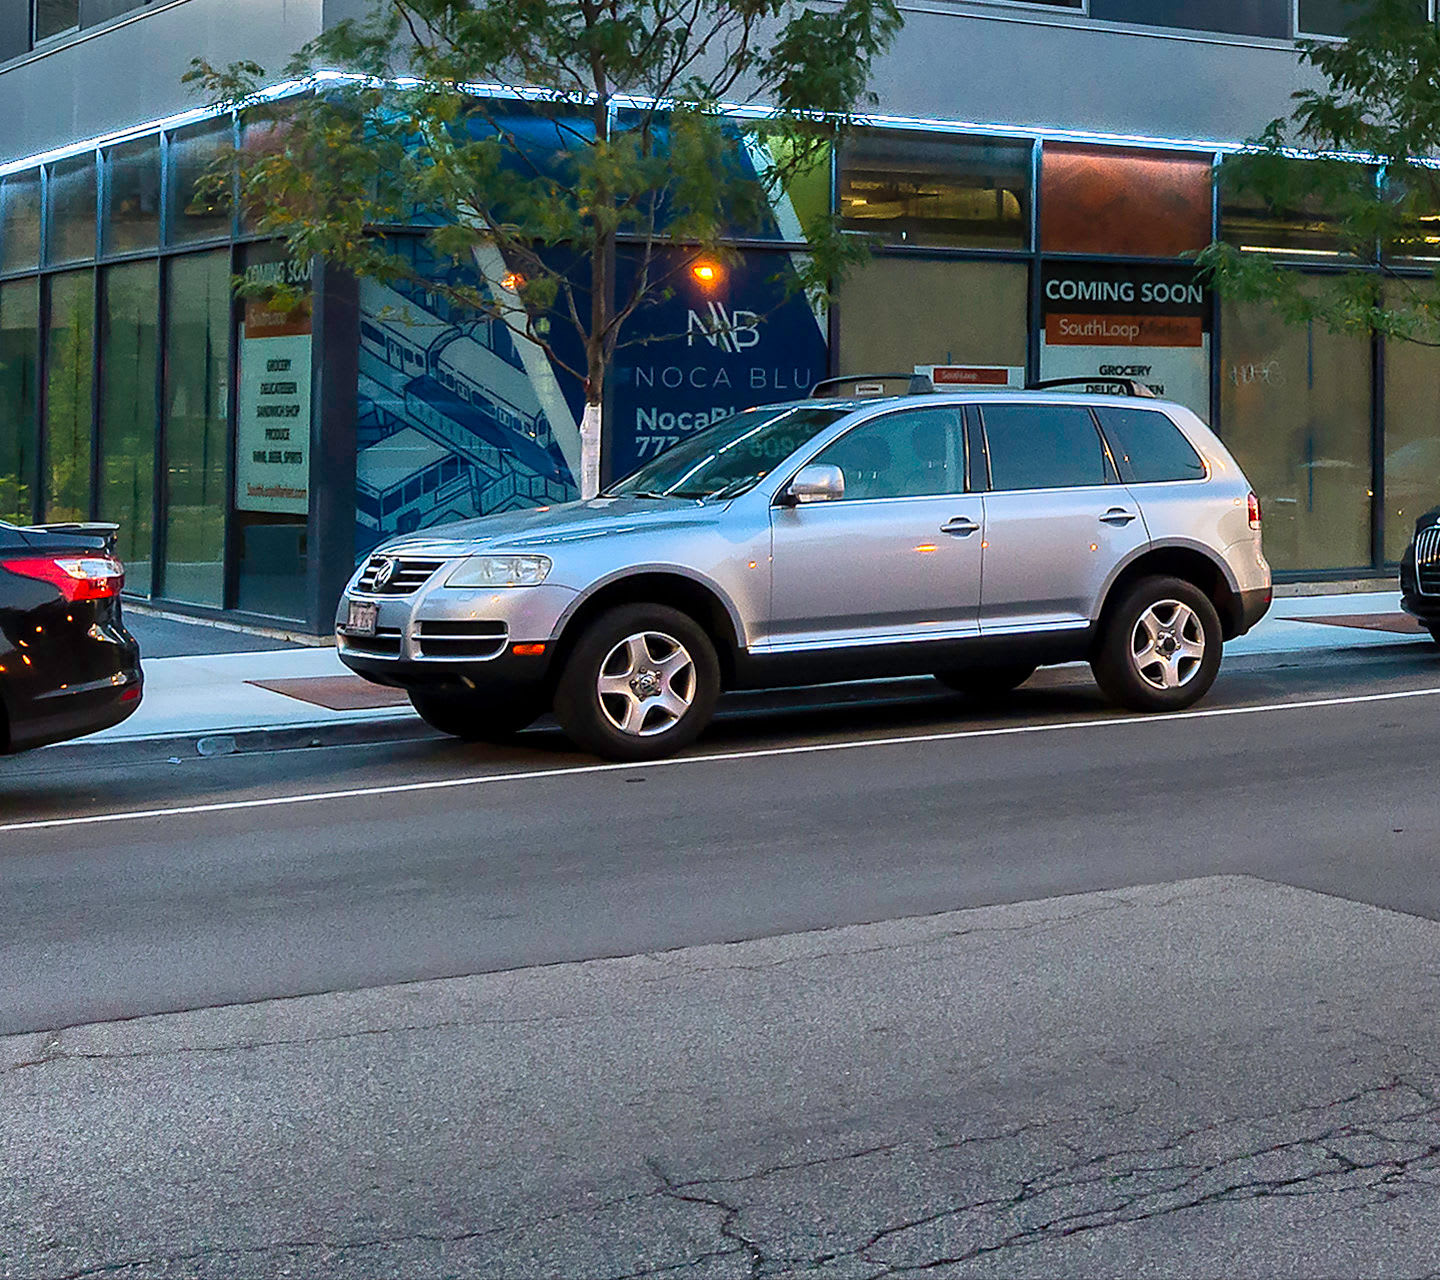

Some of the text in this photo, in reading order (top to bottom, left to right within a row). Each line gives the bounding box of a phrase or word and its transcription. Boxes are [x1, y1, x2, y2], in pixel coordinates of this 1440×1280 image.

[1046, 280, 1203, 304] COMING SOON
[1059, 318, 1140, 341] SouthLoop
[635, 366, 811, 389] NOCA BLU
[1099, 365, 1152, 376] GROCERY
[1086, 384, 1164, 395] DELICAEN
